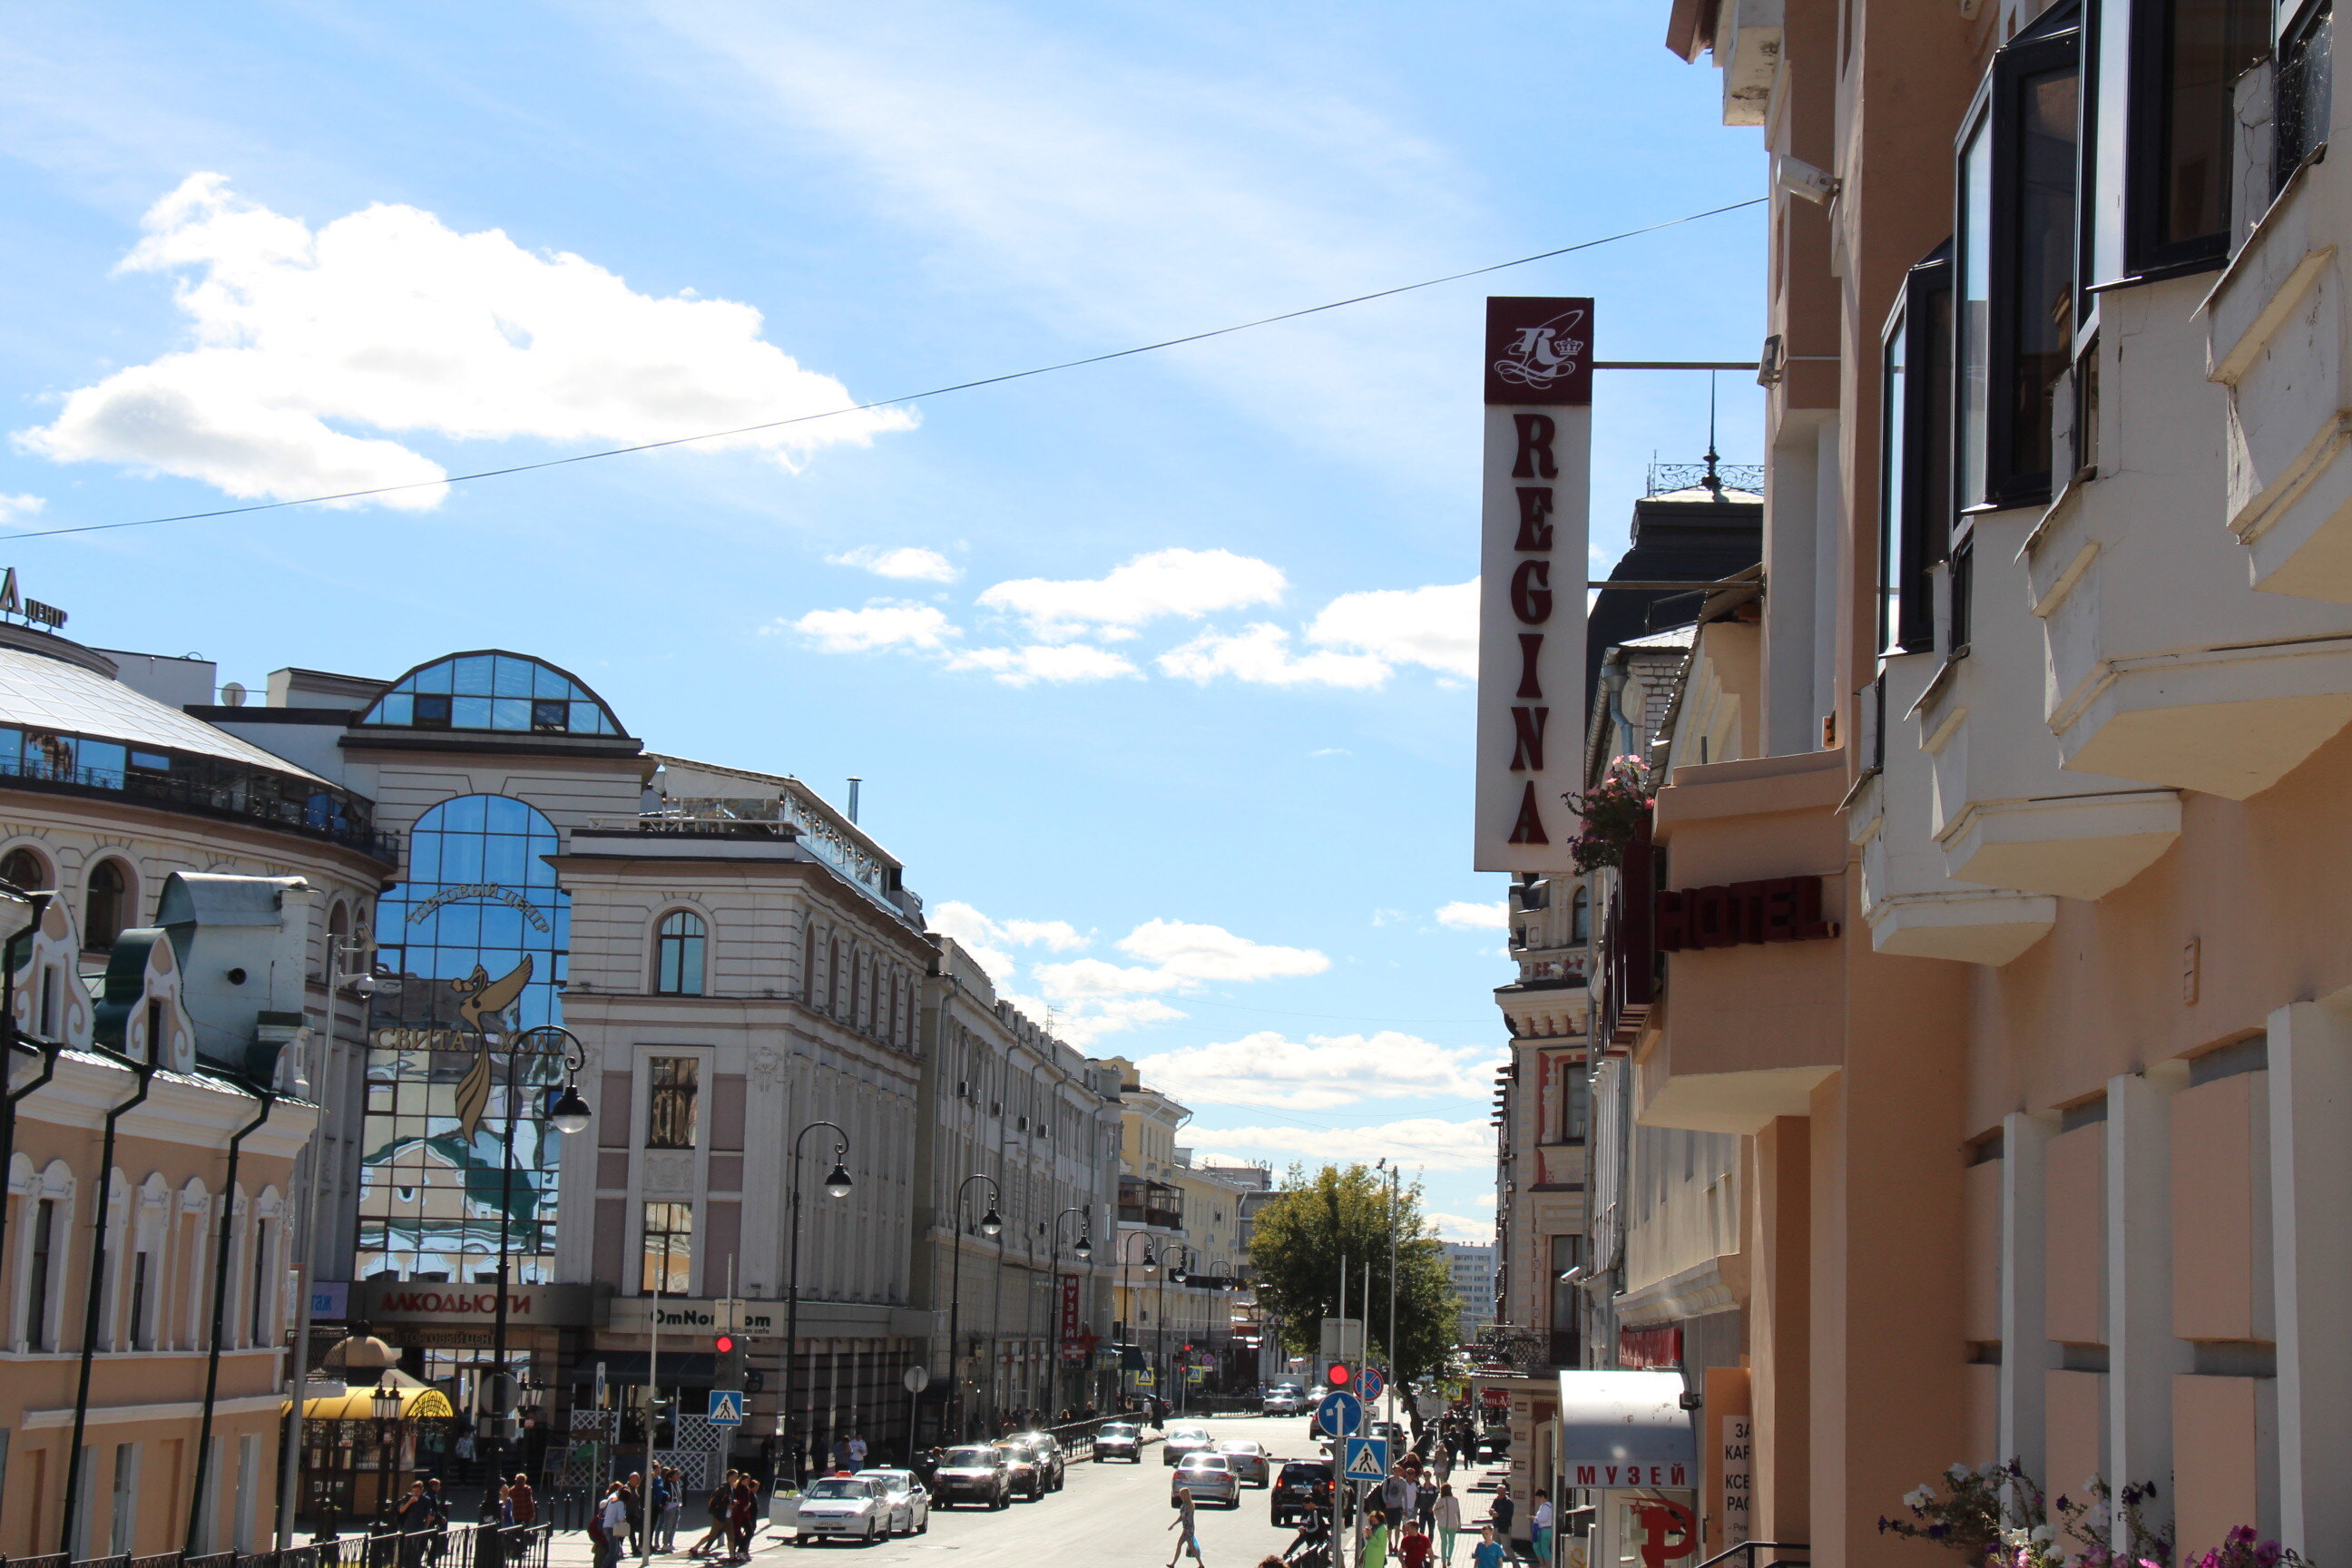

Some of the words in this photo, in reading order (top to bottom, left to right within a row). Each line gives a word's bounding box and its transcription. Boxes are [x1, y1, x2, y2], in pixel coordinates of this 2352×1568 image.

[1508, 414, 1559, 845] REGINA
[407, 882, 499, 925] ТОРГОВЫЙ
[502, 889, 551, 934] ЦЕНТР
[1655, 875, 1840, 952] HOTEL
[374, 1027, 468, 1053] СВИТА
[1065, 1279, 1077, 1338] МУЗЕЙ
[1576, 1463, 1686, 1486] МУЗЕЙ
